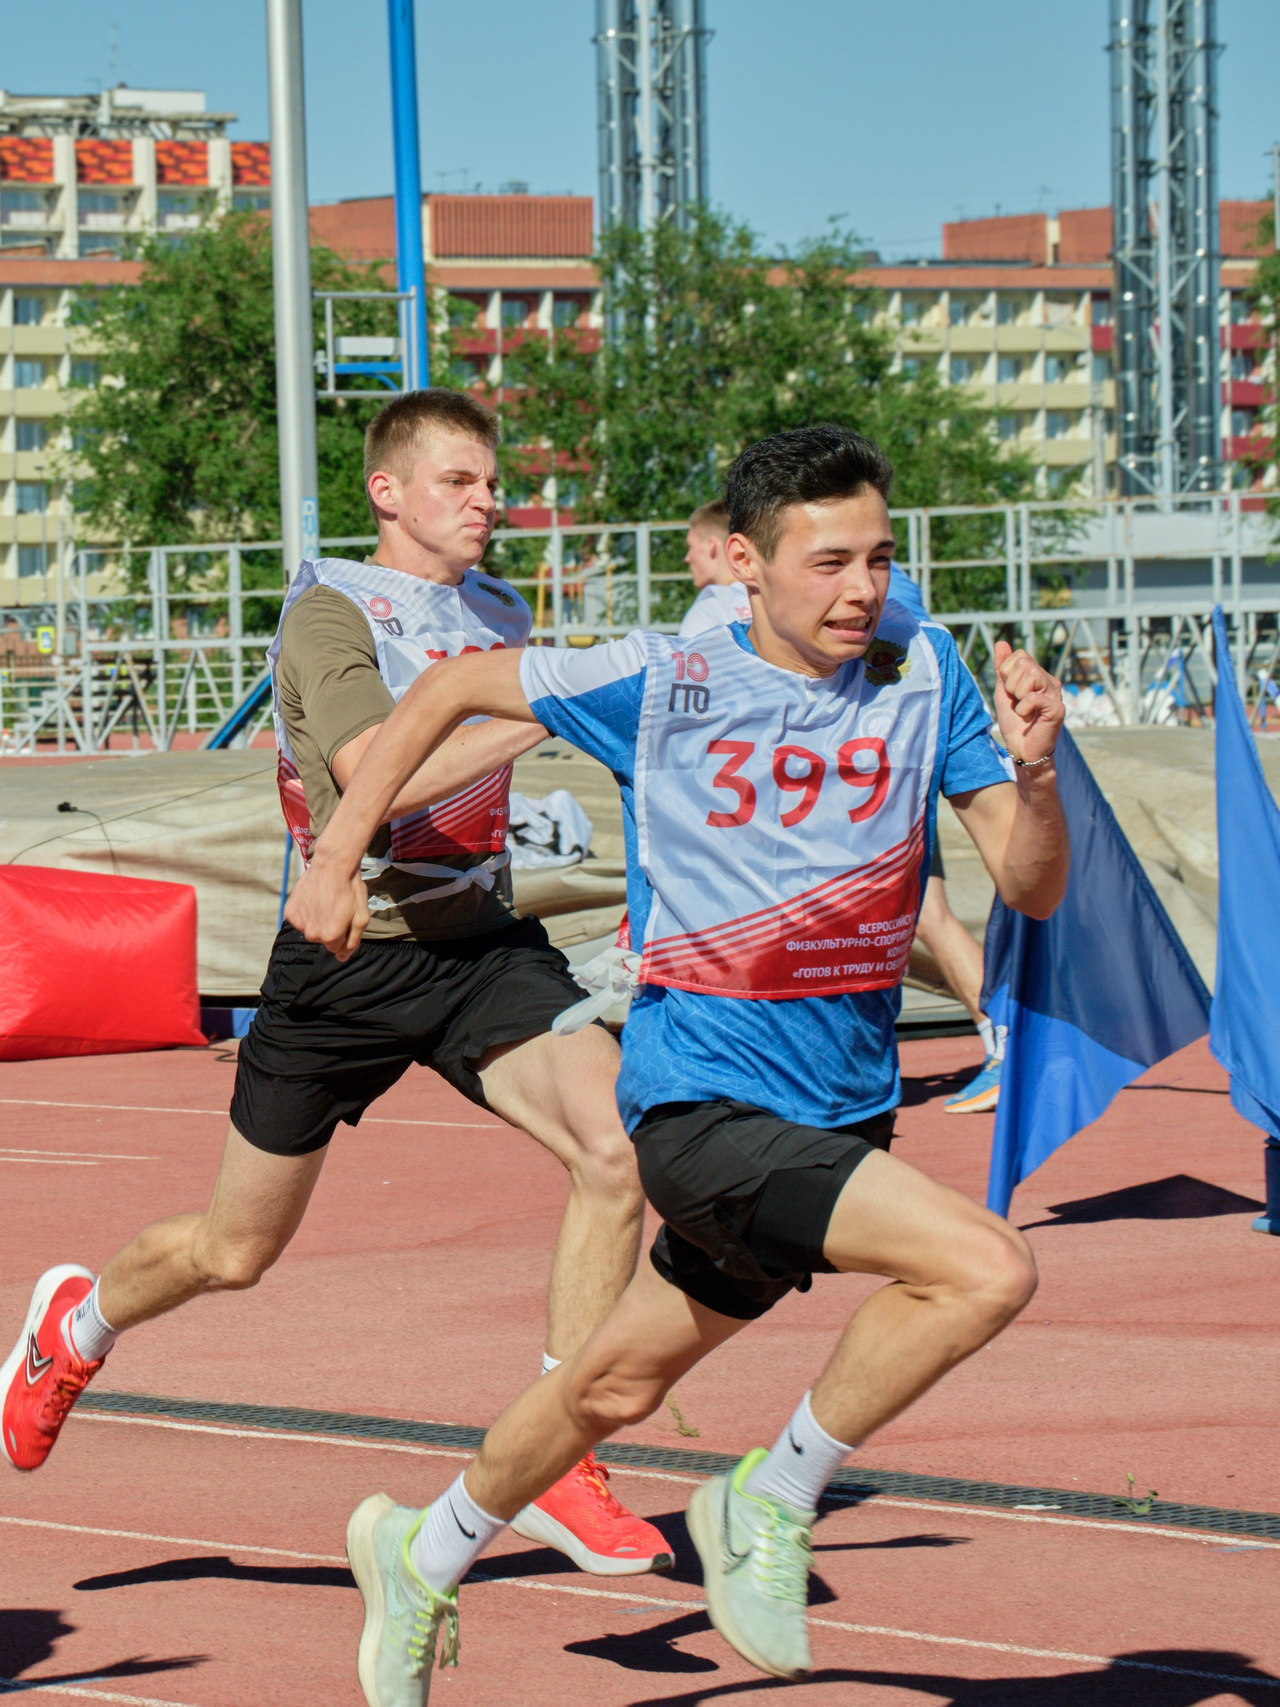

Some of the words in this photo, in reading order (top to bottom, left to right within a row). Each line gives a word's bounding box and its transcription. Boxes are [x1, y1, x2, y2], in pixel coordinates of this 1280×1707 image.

[671, 652, 710, 683] 10
[668, 683, 711, 715] ГТО
[705, 737, 891, 829] 399
[833, 965, 841, 977] К
[843, 962, 875, 976] ТРУДУ
[876, 962, 885, 972] И
